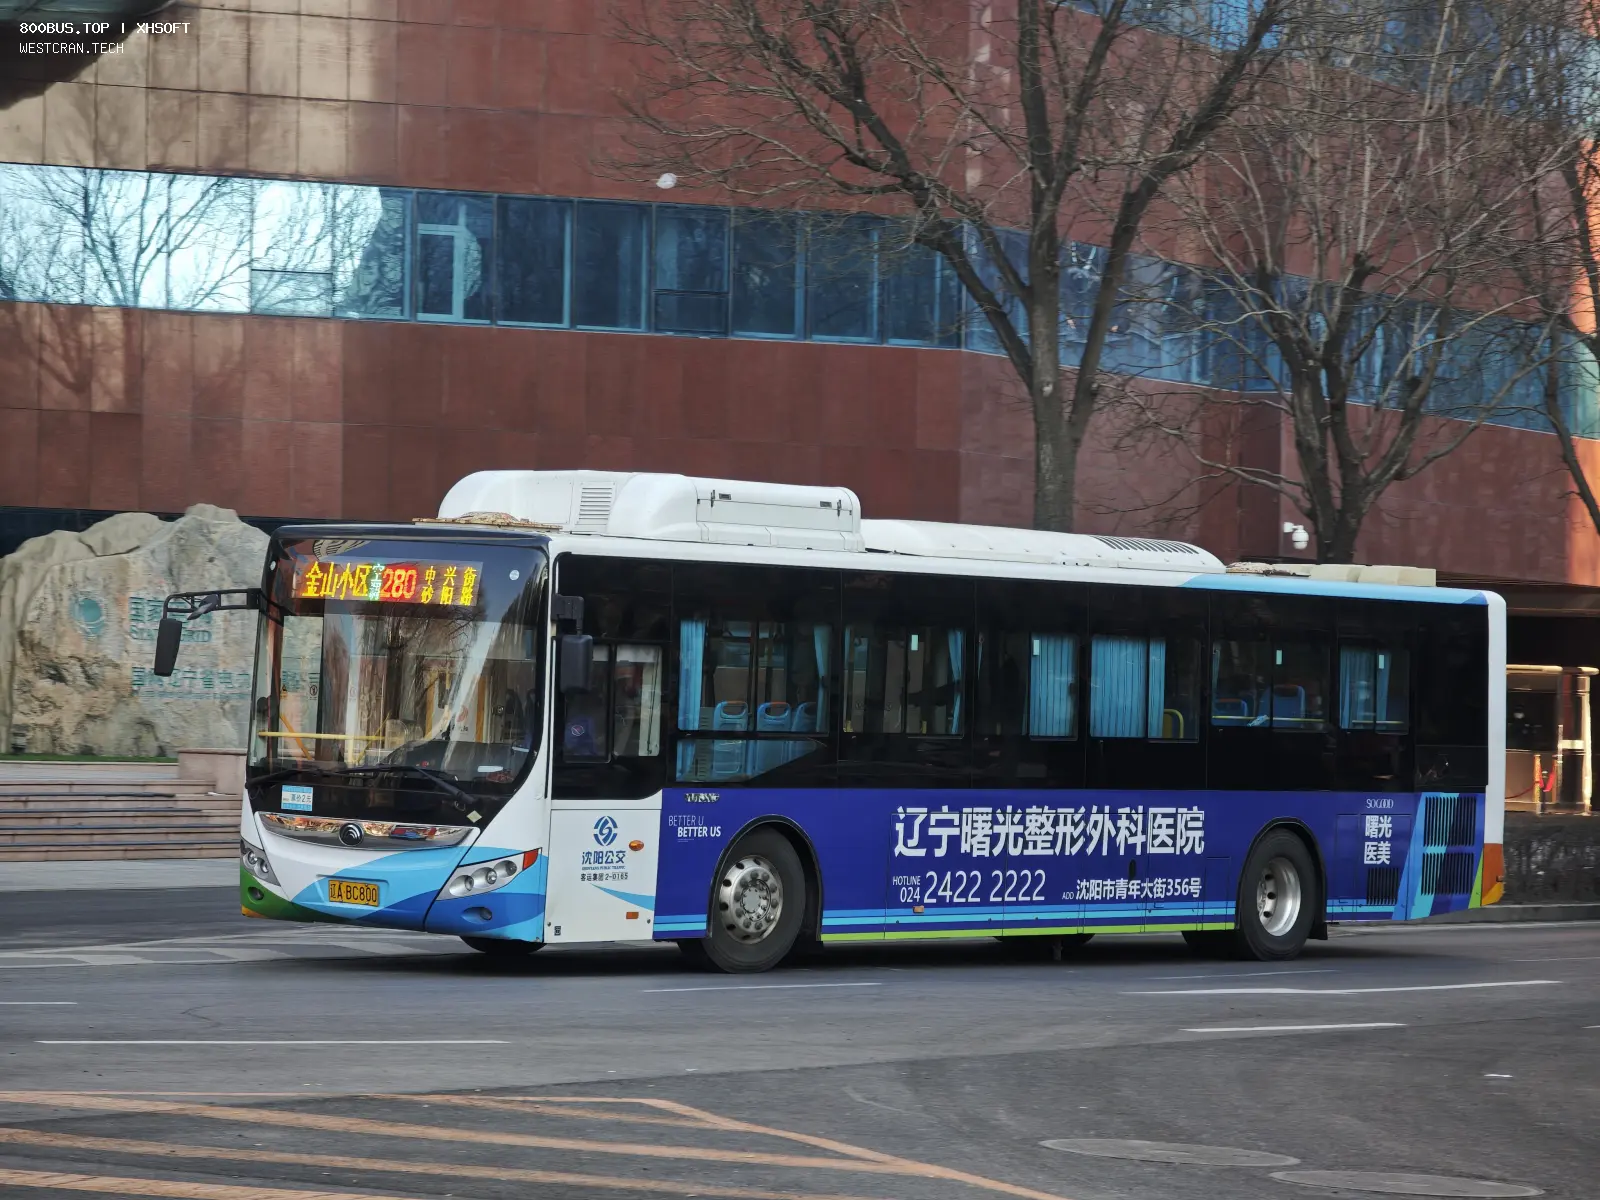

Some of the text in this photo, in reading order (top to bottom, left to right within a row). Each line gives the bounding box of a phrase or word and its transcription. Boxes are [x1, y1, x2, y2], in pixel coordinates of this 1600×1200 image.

[302, 561, 372, 600] 金山小区
[380, 568, 418, 599] 280
[668, 814, 705, 827] BETTER U
[677, 826, 722, 838] BETTER US
[893, 805, 1206, 858] 辽宁曙光整形外科医院
[1364, 815, 1393, 839] 曙光
[581, 850, 627, 865] 沈阳公交
[1363, 841, 1392, 865] 医美
[892, 875, 921, 886] HOTLINE
[900, 869, 1046, 903] 024 2422 2222
[1061, 877, 1202, 900] ADD 沈阳市青年大街356号
